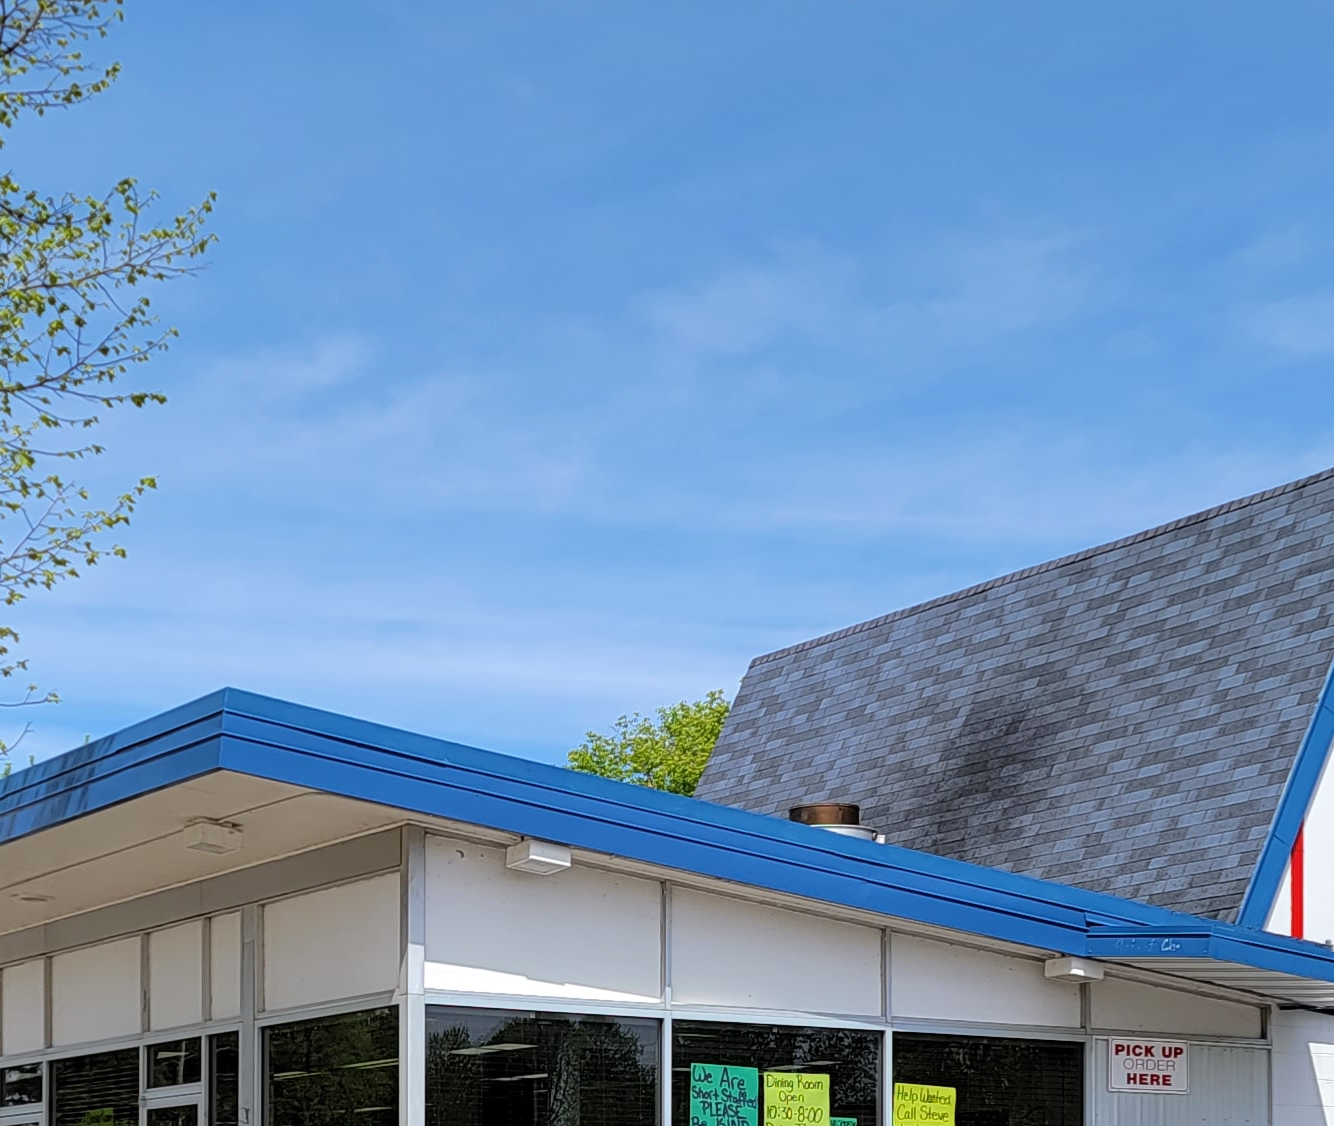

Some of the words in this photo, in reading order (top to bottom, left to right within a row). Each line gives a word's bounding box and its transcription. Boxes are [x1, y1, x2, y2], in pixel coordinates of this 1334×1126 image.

[1114, 1043, 1155, 1057] PICK
[1161, 1046, 1184, 1058] UP
[1123, 1058, 1176, 1071] ORDER
[692, 1065, 713, 1084] We
[719, 1067, 747, 1091] Are
[766, 1074, 794, 1093] Dining
[796, 1074, 824, 1090] Room
[1126, 1073, 1172, 1086] HERE
[692, 1085, 720, 1101] Short
[778, 1091, 805, 1105] Open
[897, 1085, 918, 1104] Help
[700, 1101, 747, 1119] PLEASE
[896, 1104, 917, 1120] Call
[919, 1105, 949, 1122] Steve
